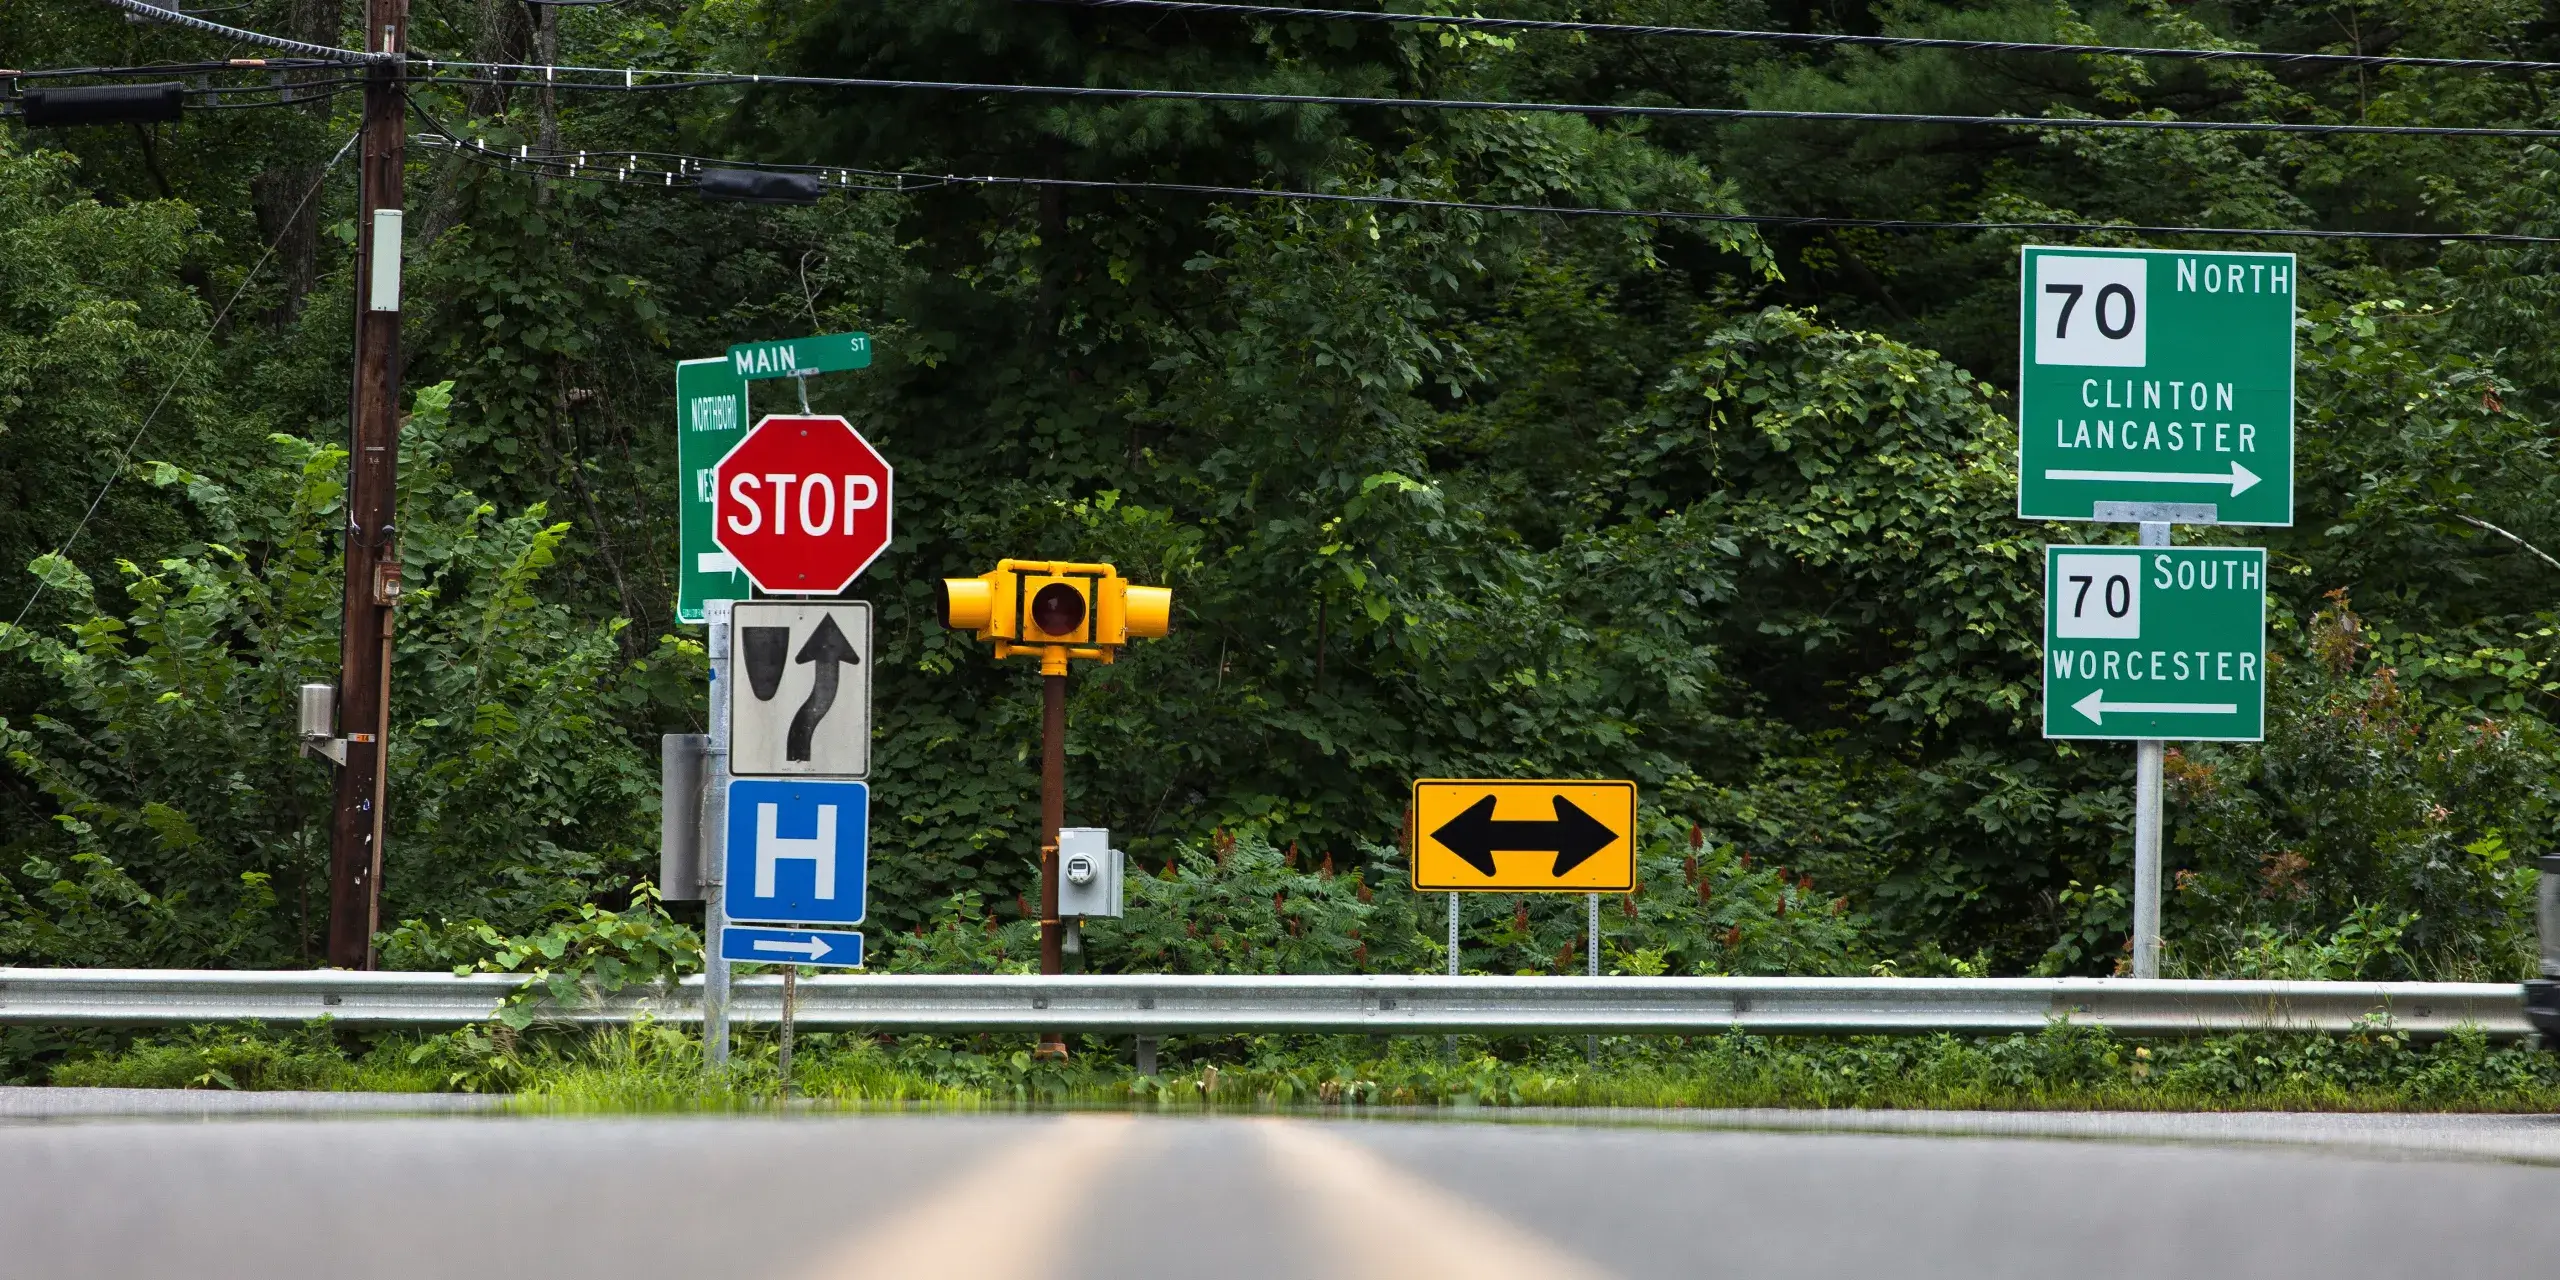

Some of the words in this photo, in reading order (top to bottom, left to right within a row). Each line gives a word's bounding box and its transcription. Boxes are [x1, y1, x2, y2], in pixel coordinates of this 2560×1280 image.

[2176, 258, 2288, 294] NORTH
[2045, 283, 2136, 340] 70
[735, 345, 796, 375] MAIN
[851, 337, 865, 351] ST
[691, 394, 737, 432] NORTHBORO
[2082, 378, 2233, 411] CLINTON
[2057, 419, 2256, 452] LANCASTER
[727, 473, 878, 536] STOP
[2153, 554, 2259, 590] SOUTH
[2069, 574, 2131, 618] 70
[2053, 650, 2256, 681] WORCESTER
[755, 803, 837, 899] H
